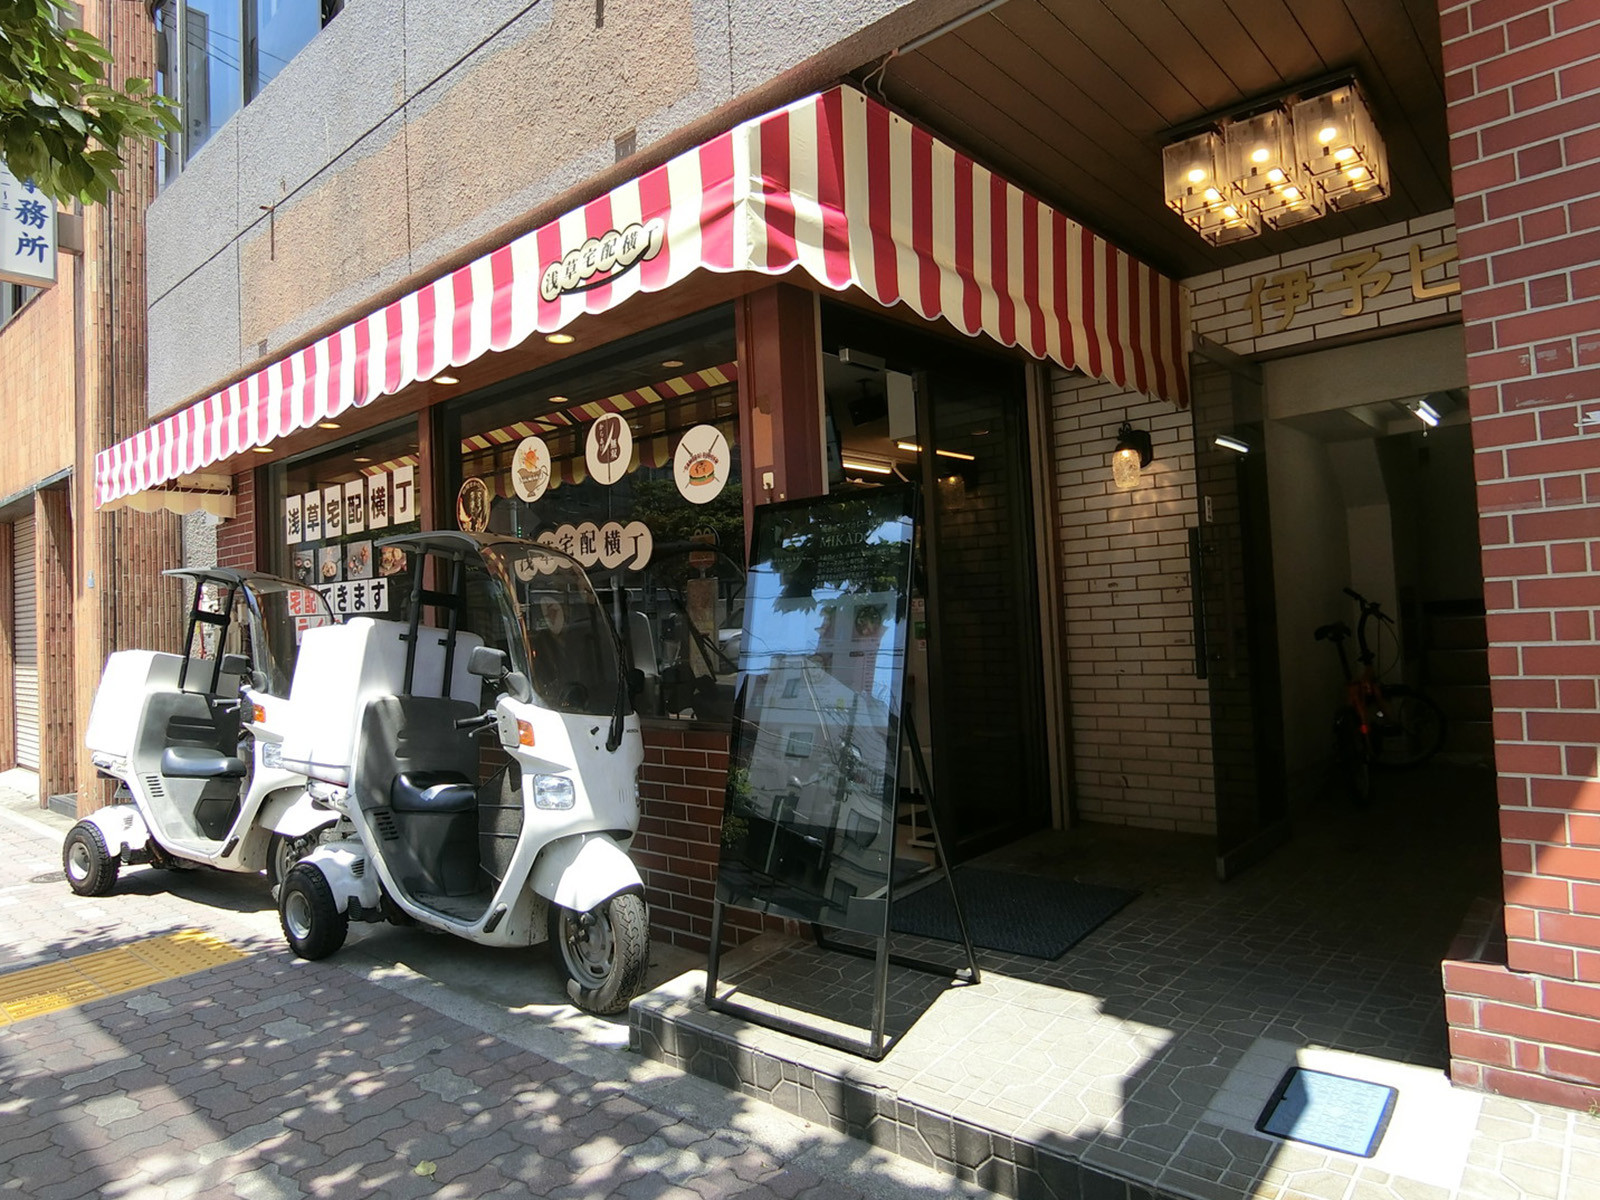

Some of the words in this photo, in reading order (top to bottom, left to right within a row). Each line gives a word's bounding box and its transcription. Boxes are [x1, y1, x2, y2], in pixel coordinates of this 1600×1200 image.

[545, 224, 660, 294] 浅草宅配横丁
[288, 480, 412, 535] 浅草宅配横丁
